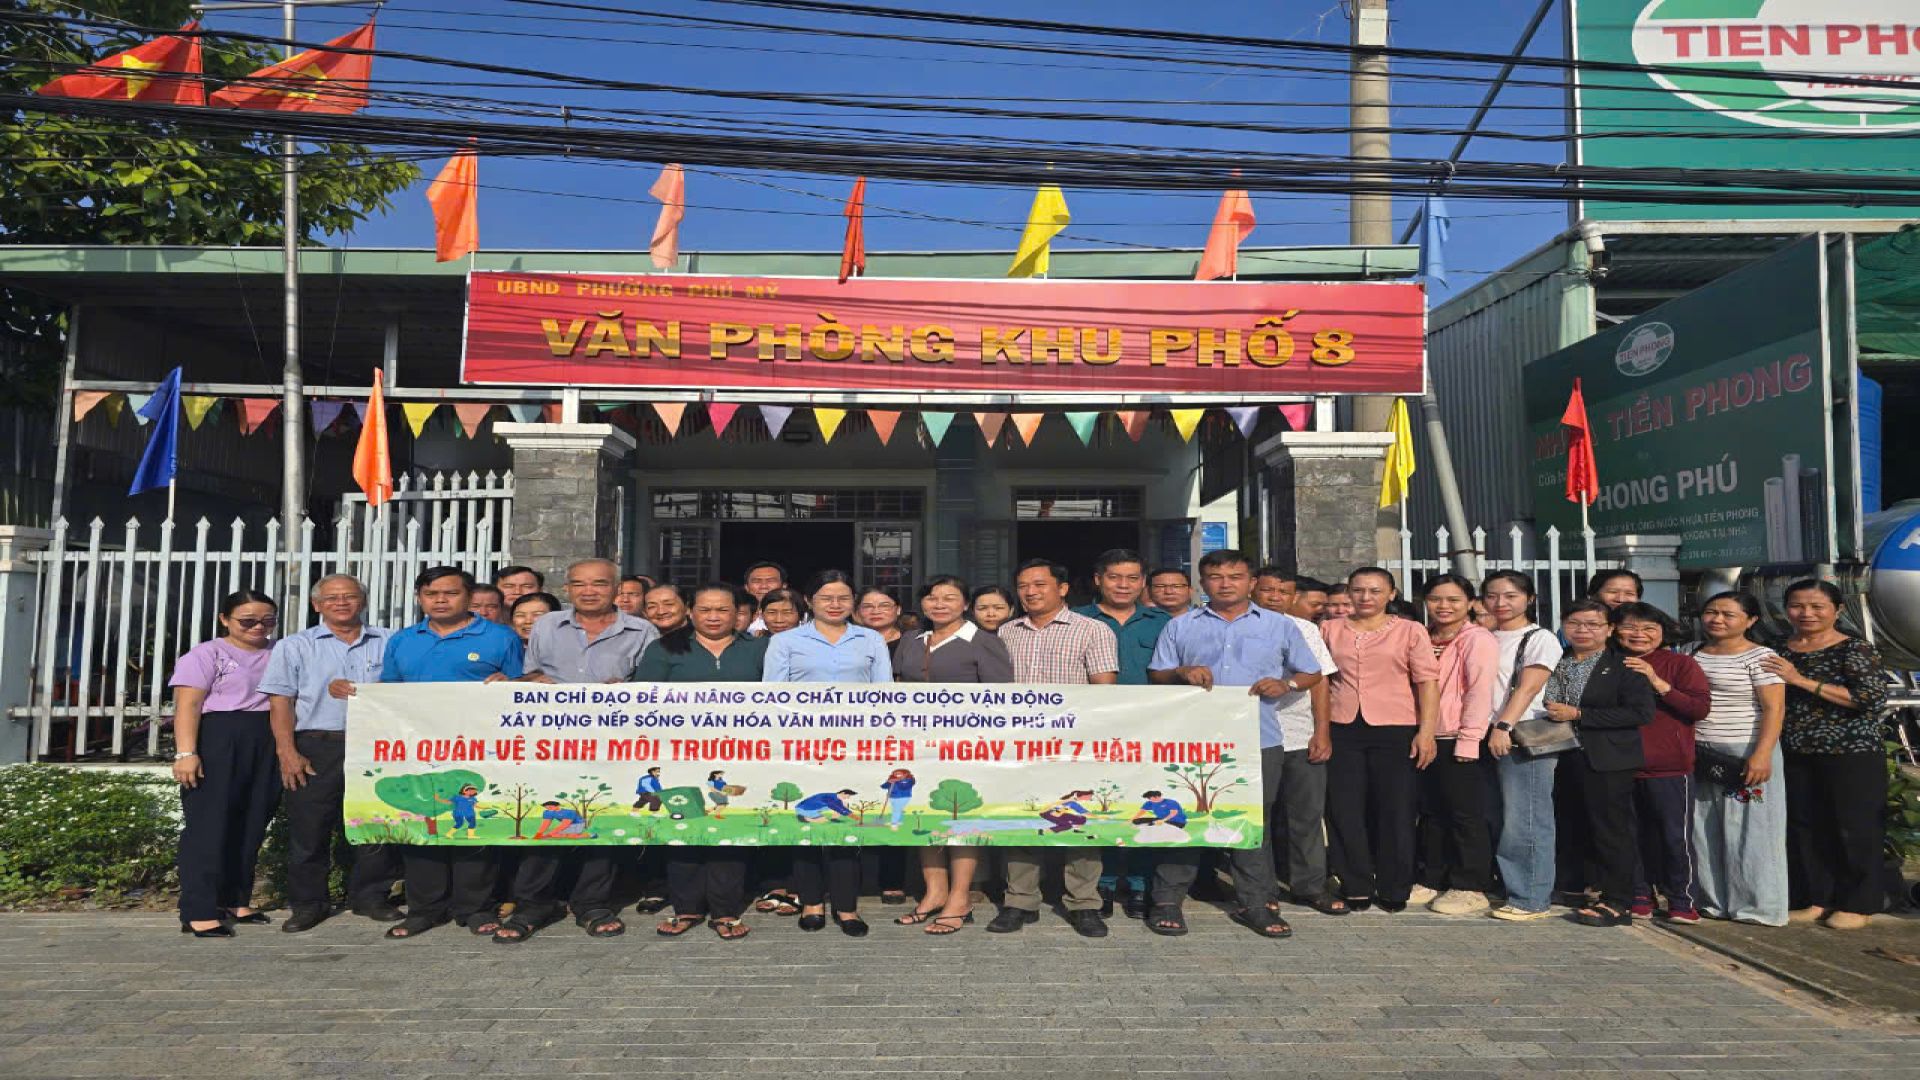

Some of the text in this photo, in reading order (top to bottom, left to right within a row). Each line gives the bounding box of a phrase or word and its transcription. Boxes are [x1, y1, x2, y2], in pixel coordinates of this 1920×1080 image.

[1663, 23, 1920, 57] TIEN PH
[498, 277, 780, 298] UBND PHƯỜNG PHÚ MỸ
[541, 309, 1356, 367] VĂN PHÒNG KHU PHỐ 8
[1684, 354, 1813, 421] PHONG
[1598, 475, 1669, 512] HONG
[1677, 453, 1738, 499] PHÚ
[1725, 506, 1760, 521] PHONG
[513, 685, 1064, 708] BAN CHỈ ĐẠO ĐỀ ÁN NÂNG CAO CHẤT LƯỢNG CUỘC VẬN ĐỘNG
[500, 711, 536, 727] XÂY
[541, 713, 592, 730] DỰNG
[598, 709, 630, 727] NẾP
[635, 709, 685, 728] SỐNG
[691, 711, 727, 728] VĂN
[733, 710, 772, 728] HÓA
[778, 711, 814, 728] VĂN
[820, 715, 864, 728] MINH
[870, 711, 896, 728] ĐÔ
[902, 714, 927, 731] THỊ
[932, 711, 1006, 728] PHƯỜNG
[1051, 712, 1076, 729] MỸ
[374, 739, 406, 762] RA
[416, 735, 486, 763] QUÂN
[495, 735, 525, 765] VỆ
[535, 739, 598, 762] SINH
[607, 735, 660, 762] MÔI
[670, 735, 771, 762] TRƯỜNG
[781, 737, 847, 766] THỰC
[857, 735, 915, 766] HIỆN
[1014, 736, 1063, 762] THỨ
[1069, 740, 1084, 763] 7
[1092, 737, 1141, 763] VĂN
